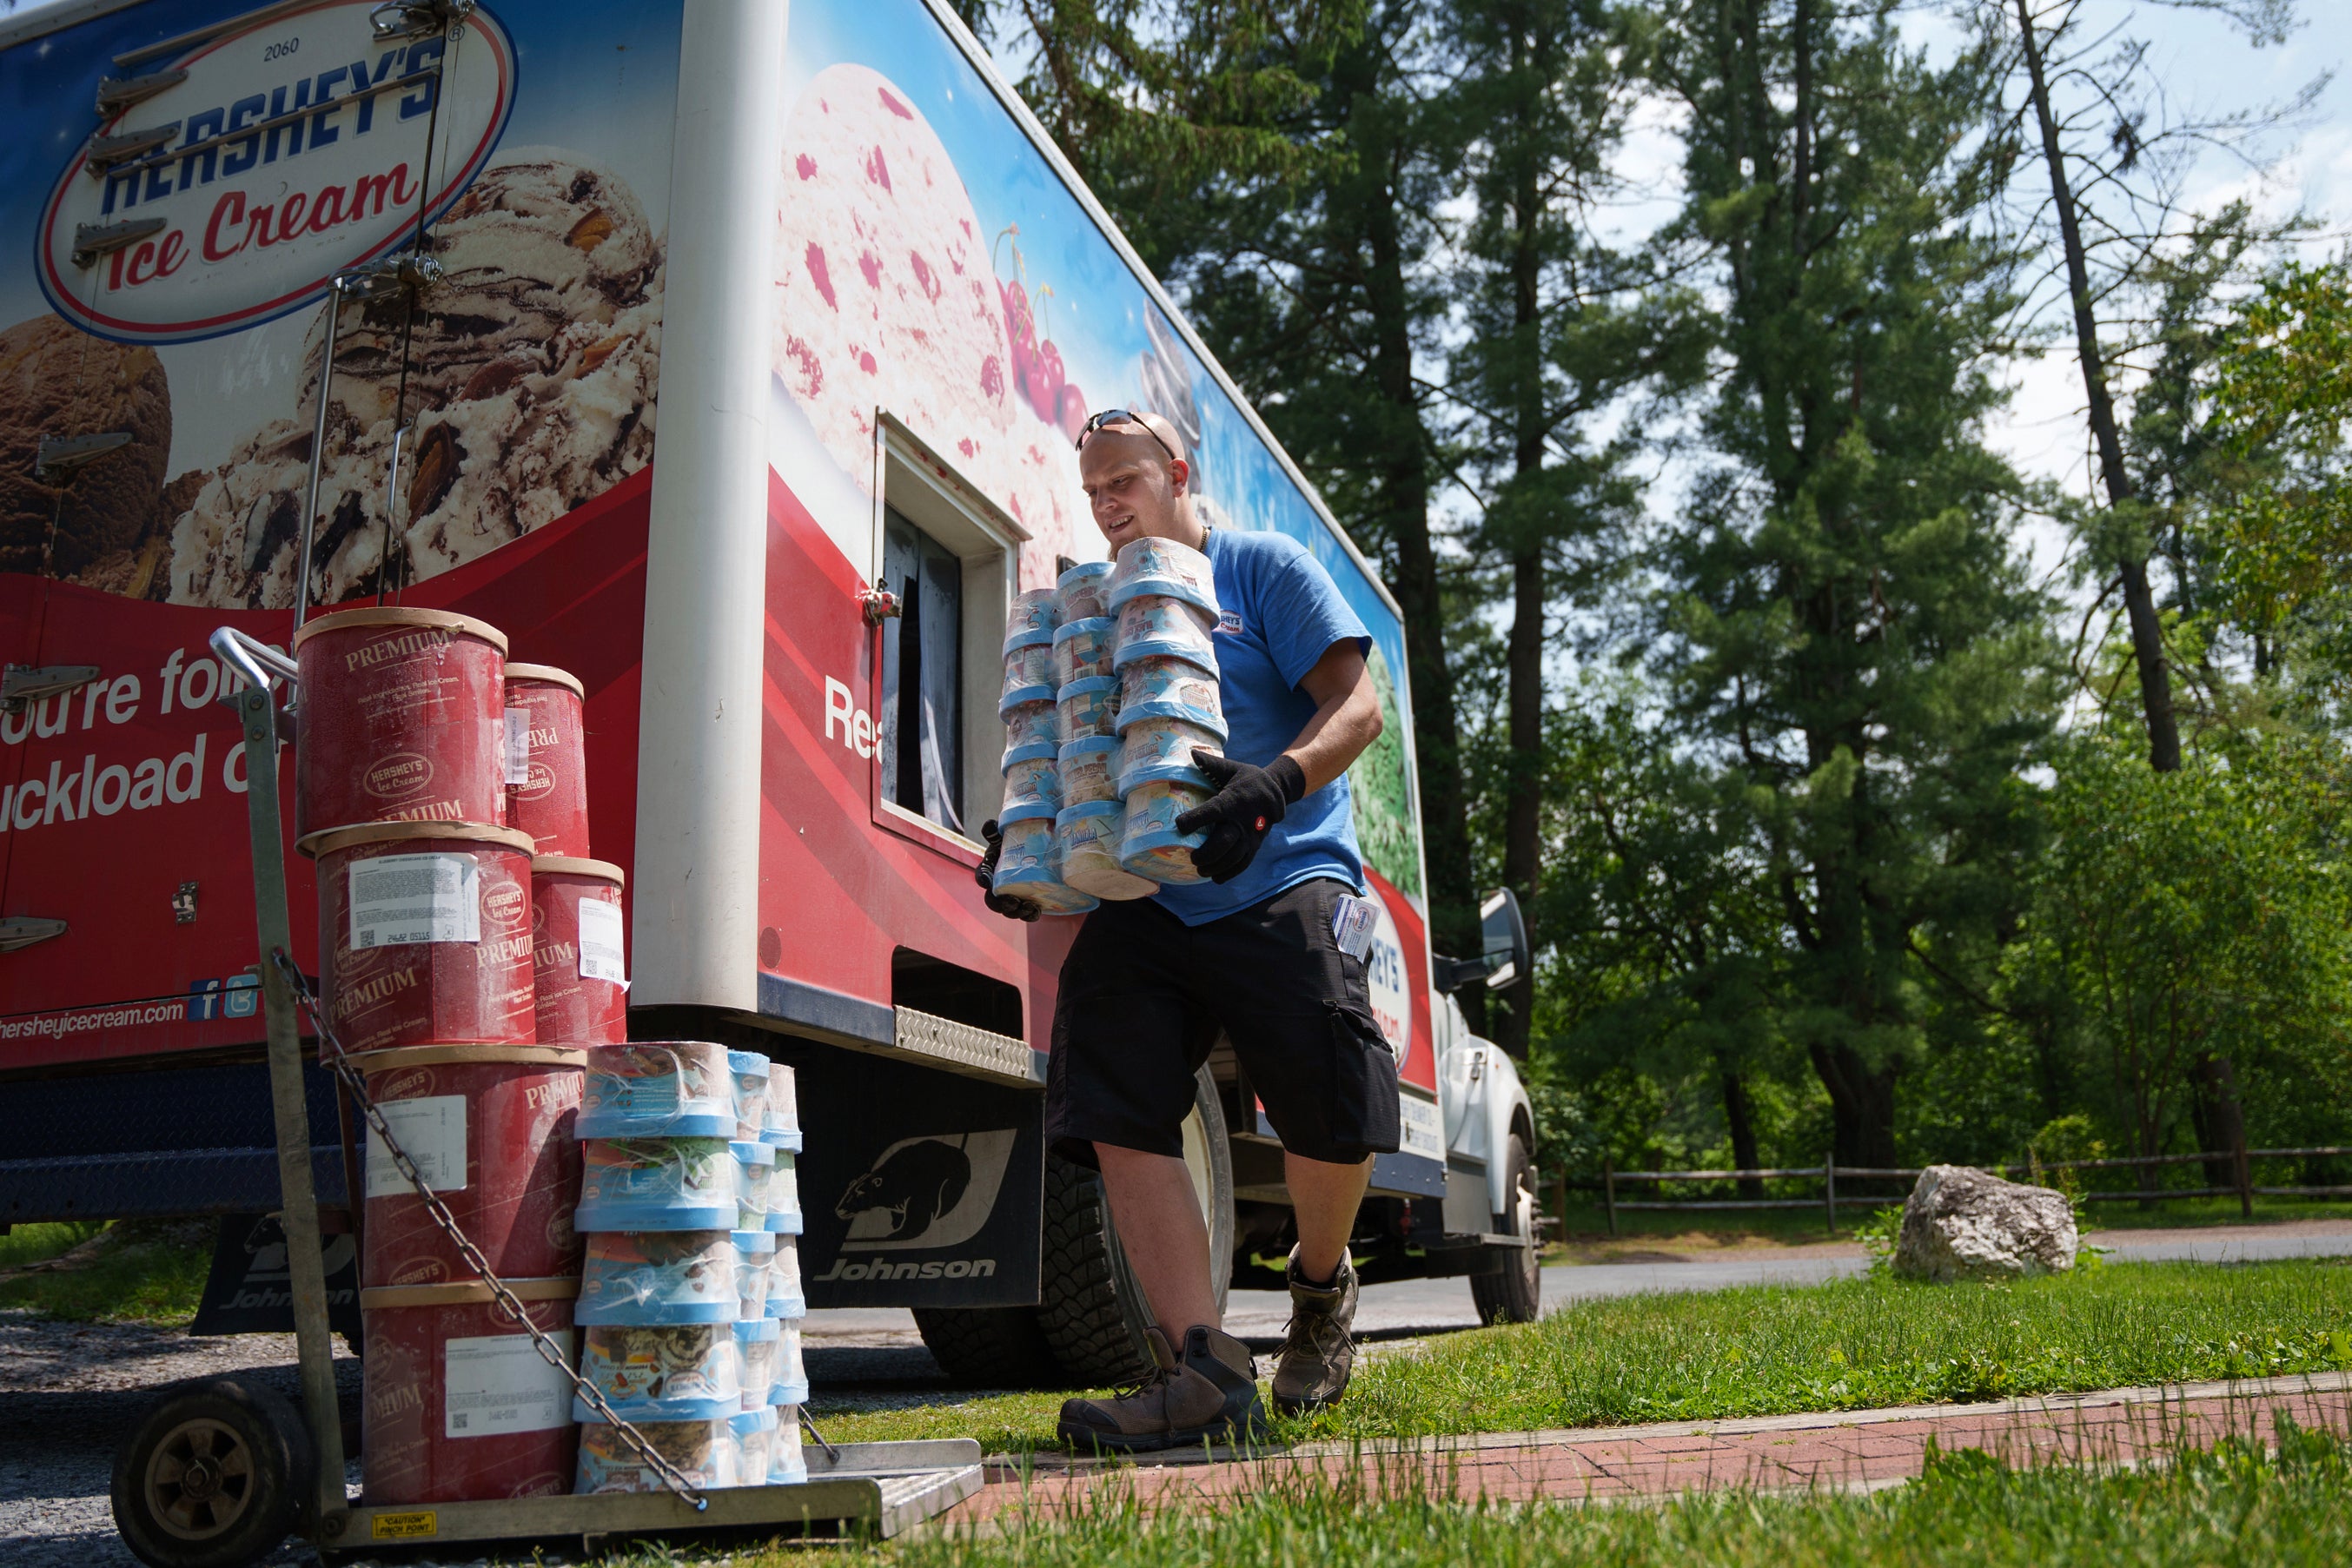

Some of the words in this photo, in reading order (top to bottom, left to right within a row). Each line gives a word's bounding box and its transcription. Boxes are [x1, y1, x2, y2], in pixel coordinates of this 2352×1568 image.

[263, 37, 299, 61] 2060
[101, 36, 446, 215] HERSHEY'S
[108, 219, 190, 293] Ice
[200, 162, 419, 262] Cream
[345, 630, 452, 673] PREMIUM
[0, 677, 140, 745] ou're
[825, 674, 883, 764] Re
[371, 759, 423, 784] HERSHEY'S
[376, 781, 391, 792] Ice
[392, 774, 425, 788] Cream
[476, 932, 533, 967] PREMIU
[329, 966, 419, 1024] PREMIUM
[524, 1070, 585, 1110] PREMIU
[812, 1257, 997, 1281] Johnson
[217, 1287, 354, 1310] Johnn
[380, 1525, 404, 1534] PINCH
[406, 1524, 430, 1532] POINT
